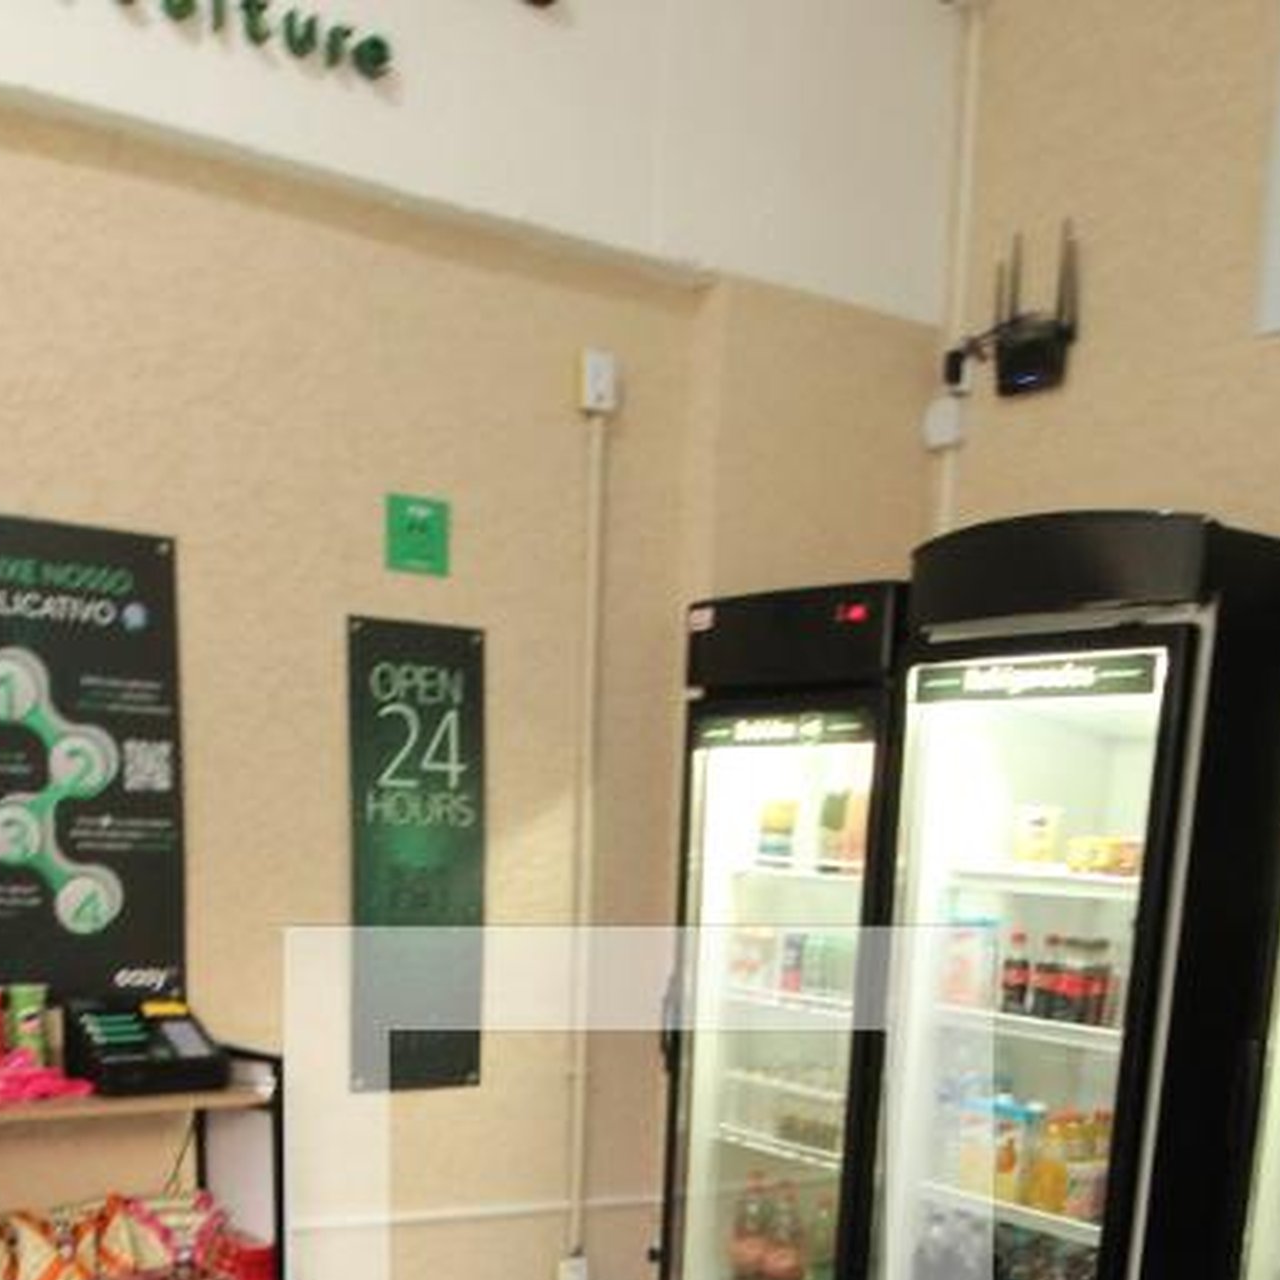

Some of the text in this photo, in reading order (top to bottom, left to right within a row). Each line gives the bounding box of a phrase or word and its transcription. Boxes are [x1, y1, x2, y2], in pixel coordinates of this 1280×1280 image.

[41, 562, 135, 597] NOSSO
[370, 661, 465, 704] OPEN
[376, 702, 469, 790] 24
[365, 791, 477, 829] HOURS
[114, 967, 169, 991] easy
